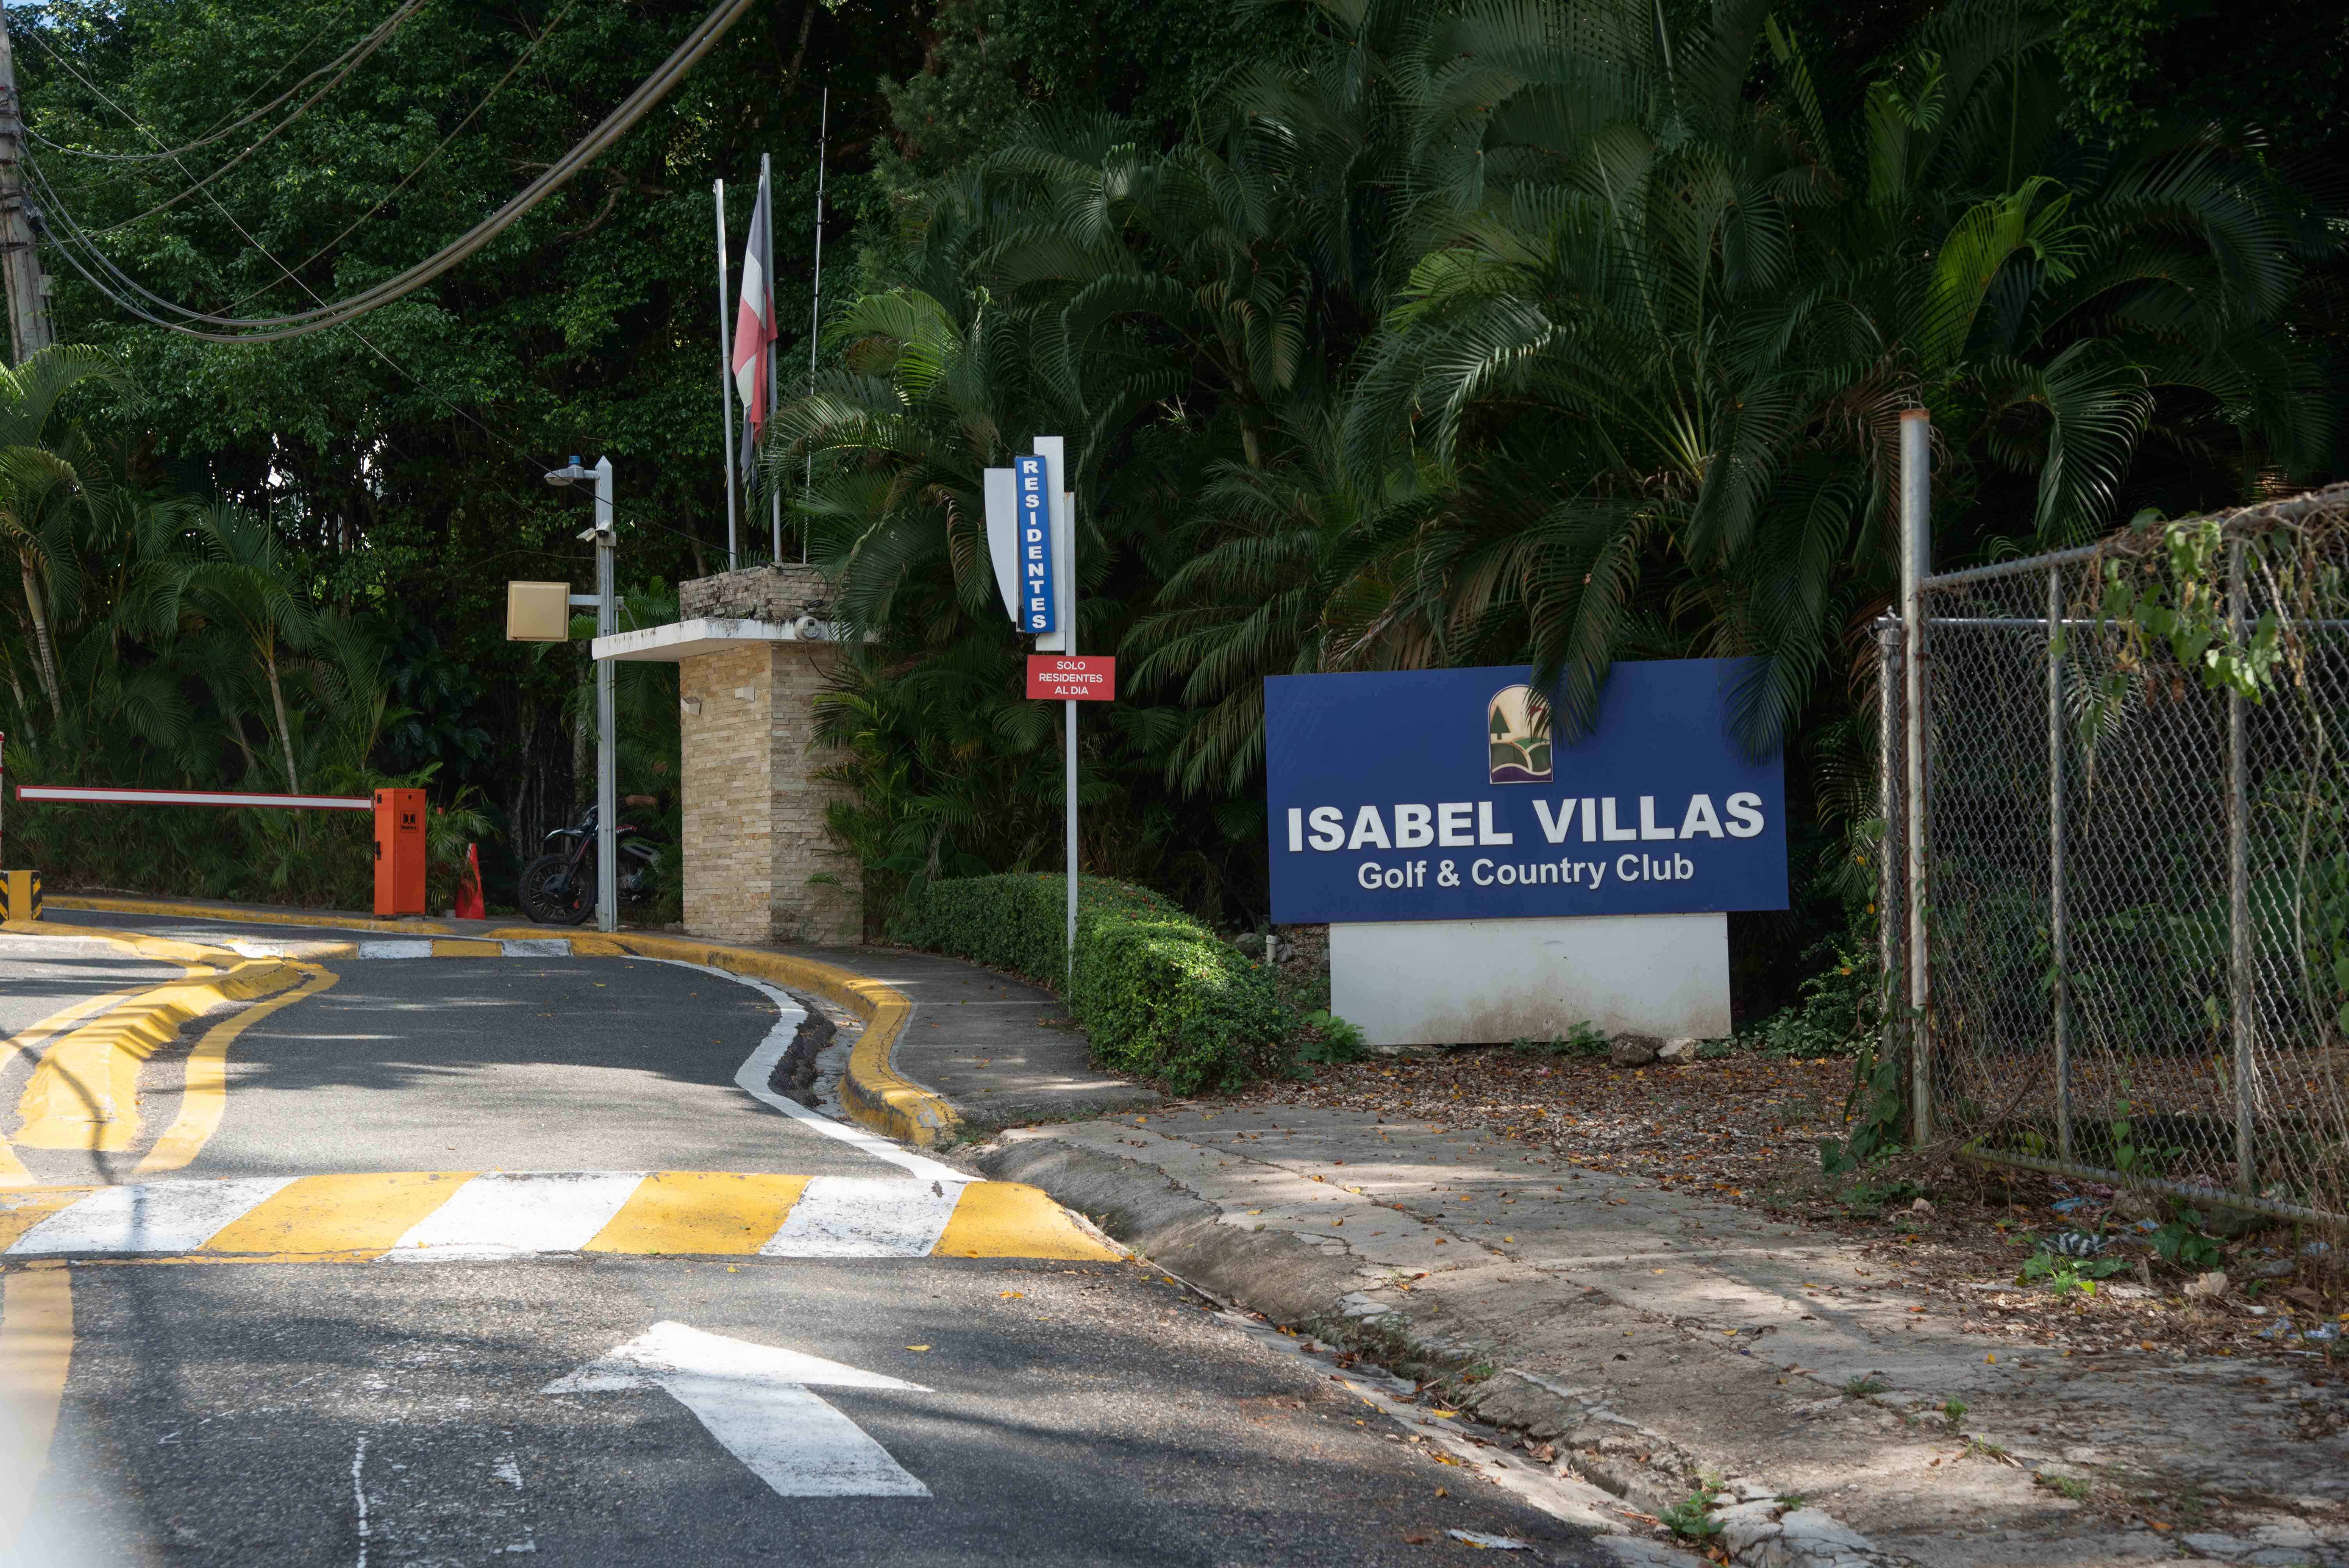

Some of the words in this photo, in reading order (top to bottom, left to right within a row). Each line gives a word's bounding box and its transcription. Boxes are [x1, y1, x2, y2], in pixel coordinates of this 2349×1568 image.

[1023, 460, 1046, 629] RESIDENTES
[1057, 661, 1085, 670] SOLO
[1039, 673, 1103, 683] RESIDENTES
[1054, 686, 1069, 695] AL
[1071, 686, 1089, 695] DIA
[1288, 801, 1513, 852] ISABEL
[1532, 792, 1764, 843] VILLAS
[1358, 860, 1427, 889] Golf
[1437, 859, 1461, 887] &
[1471, 857, 1607, 890] Country
[1616, 853, 1694, 882] Club
